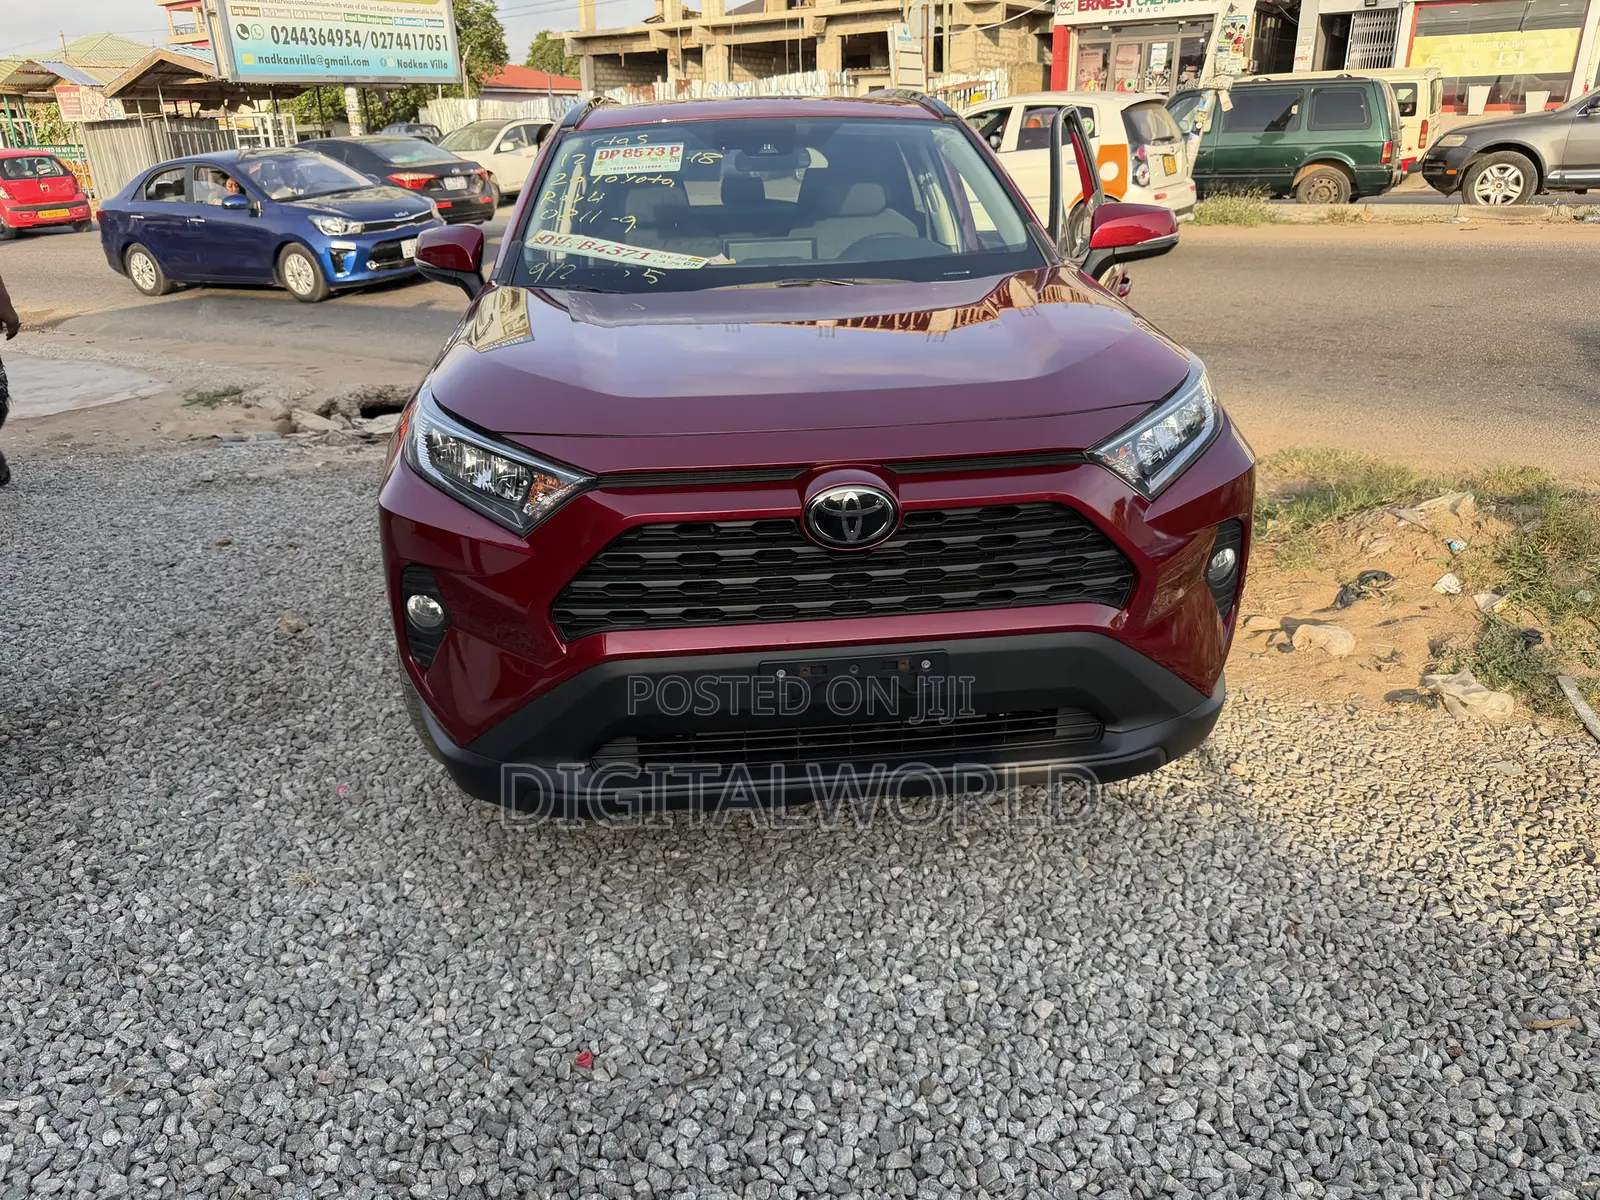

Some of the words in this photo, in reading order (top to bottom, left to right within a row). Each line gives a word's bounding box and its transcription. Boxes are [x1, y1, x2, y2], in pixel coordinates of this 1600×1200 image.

[1108, 6, 1166, 16] PHARMACY
[270, 25, 449, 51] 0244364954/0274417051
[257, 53, 370, 68] nadkanvilla@gmail.com
[397, 59, 428, 69] Nadkan
[431, 60, 448, 69] Villa
